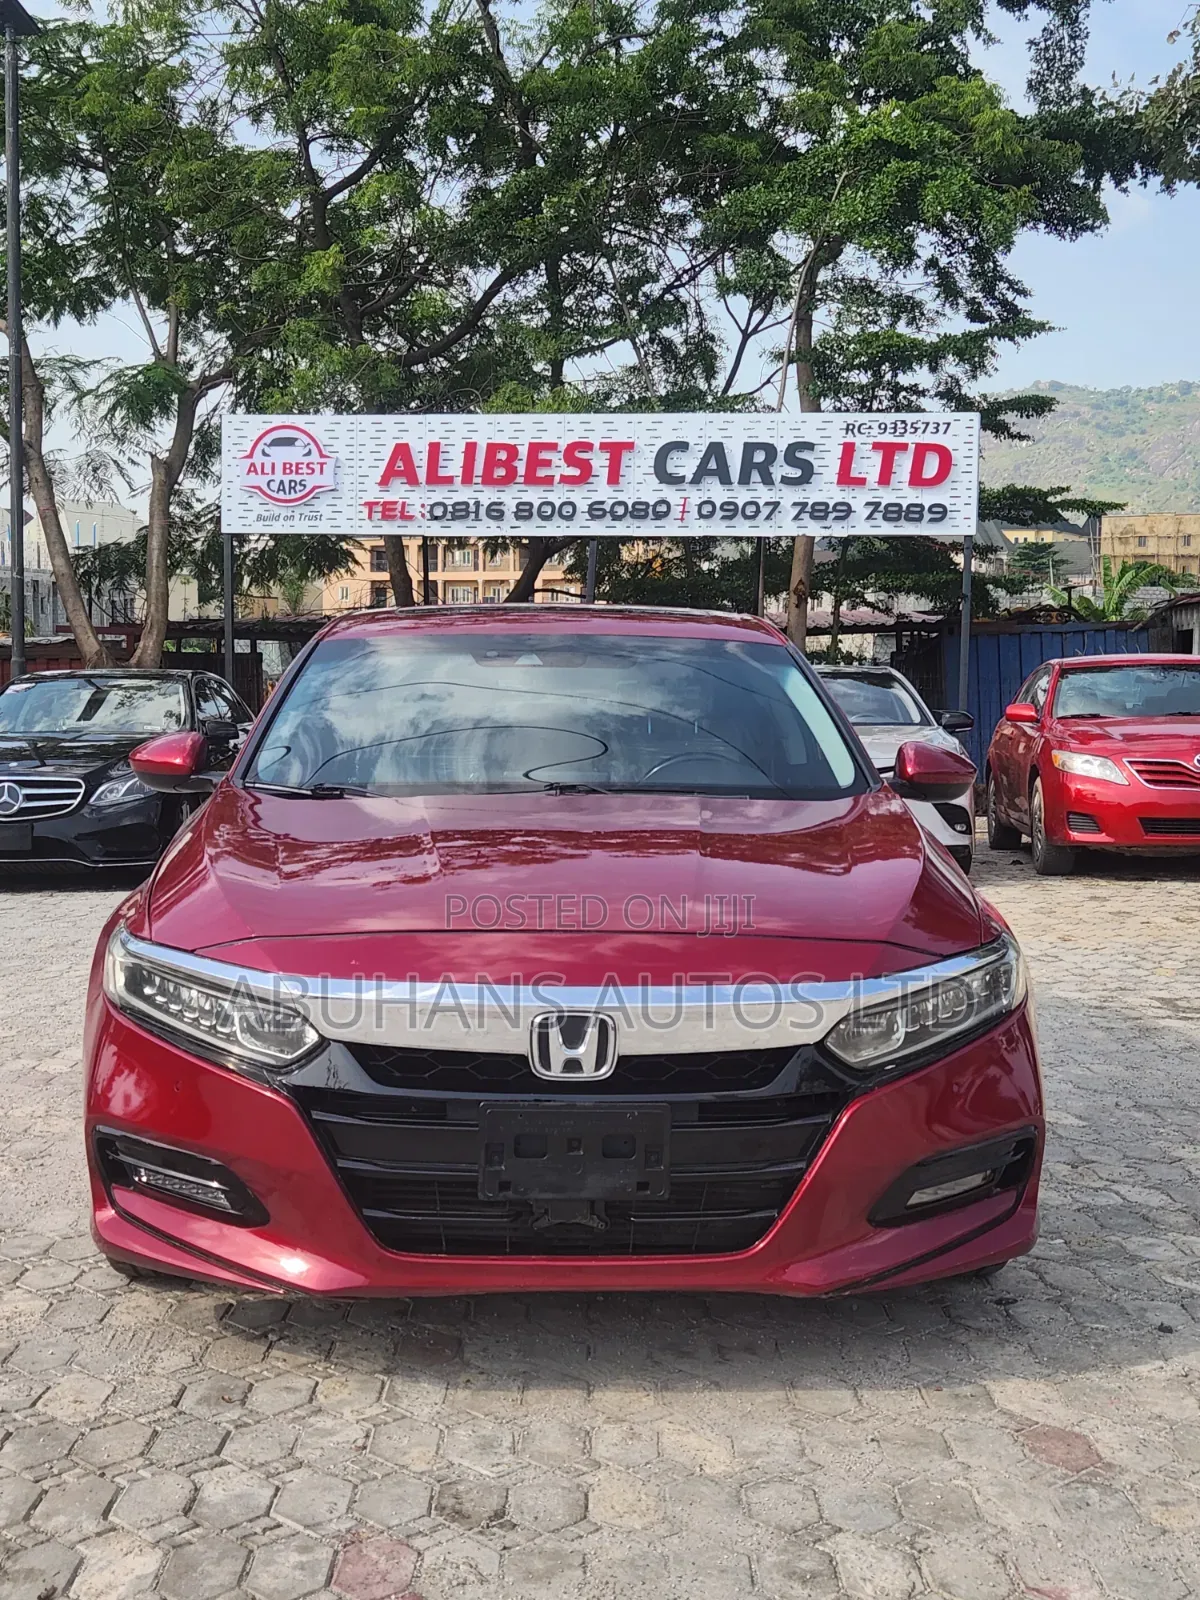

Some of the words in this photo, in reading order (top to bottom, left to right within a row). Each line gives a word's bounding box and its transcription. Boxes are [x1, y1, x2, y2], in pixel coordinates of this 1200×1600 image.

[878, 421, 952, 435] 9335737
[246, 462, 276, 475] ALI
[282, 462, 327, 475] BEST
[378, 441, 635, 487] ALIBEST
[653, 440, 816, 486] CARS
[836, 441, 953, 488] LTD
[266, 479, 307, 495] CARS
[256, 514, 280, 522] Build
[299, 513, 323, 522] Trust
[513, 500, 577, 521] 800
[587, 499, 672, 520] 6080
[697, 500, 781, 520] 0907
[791, 501, 851, 521] 789
[864, 501, 948, 522] 7889
